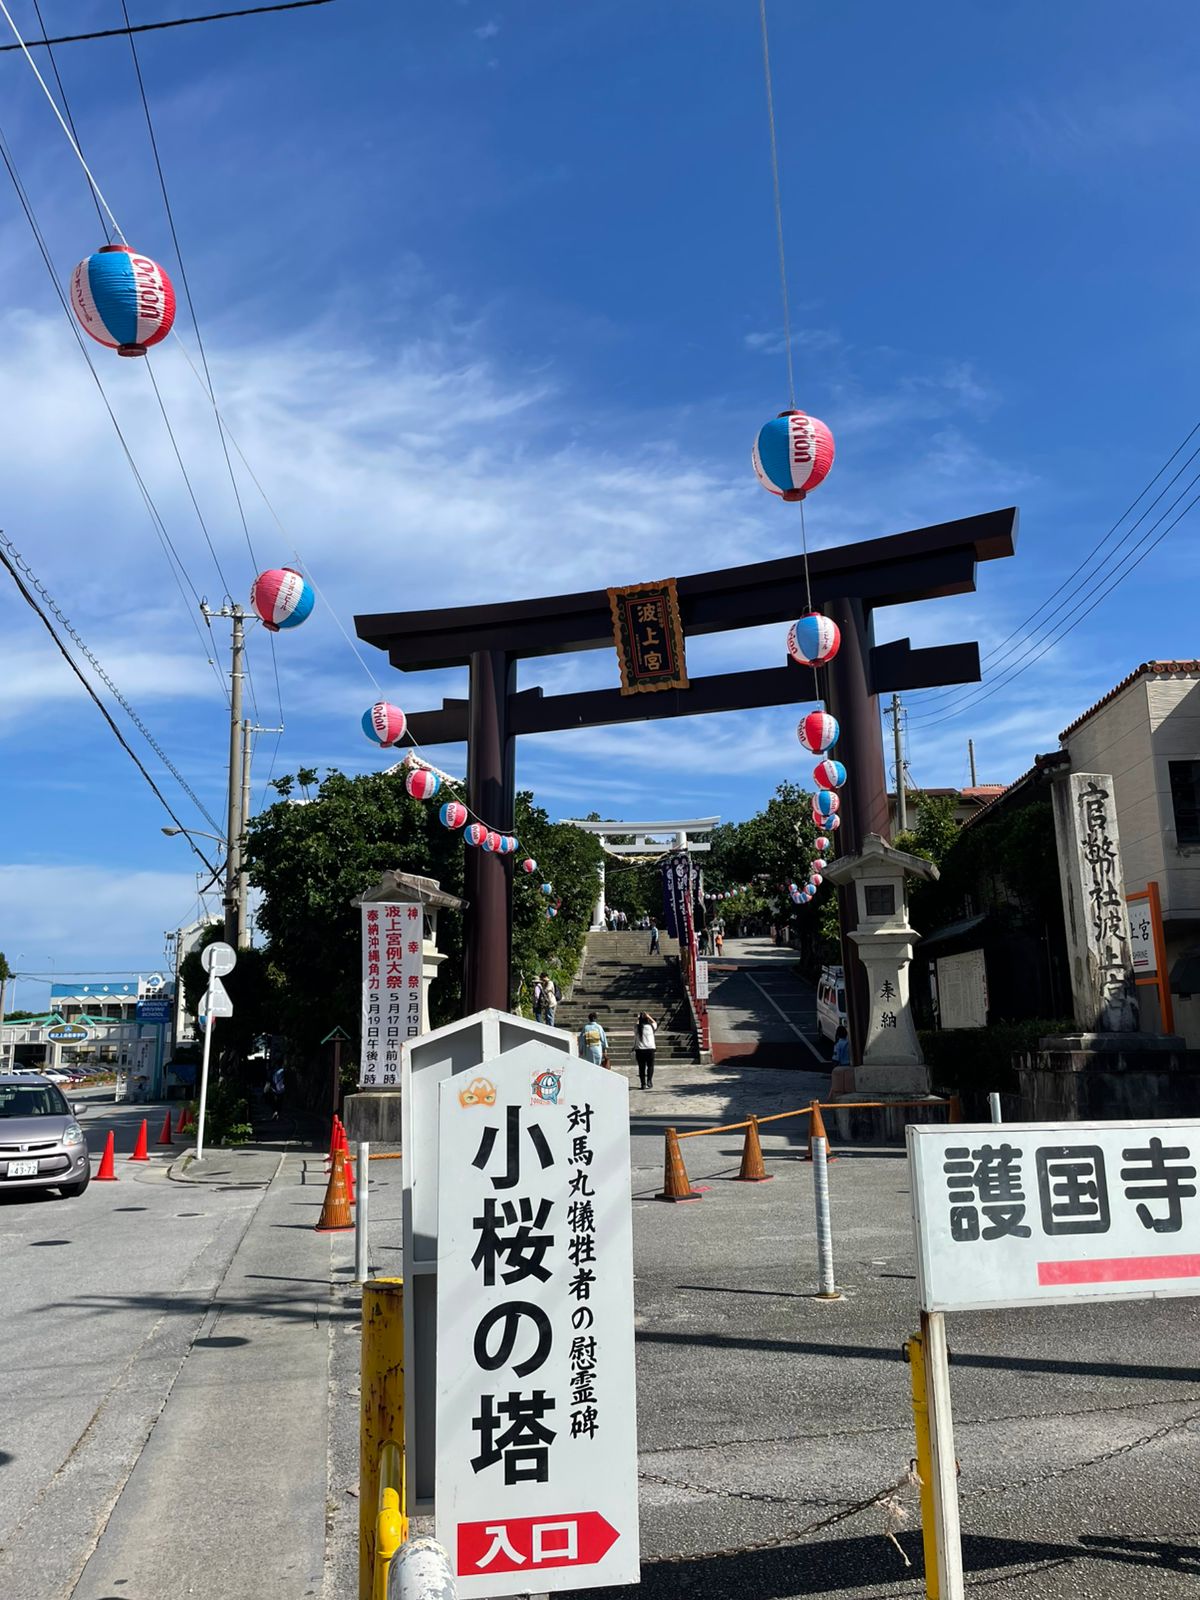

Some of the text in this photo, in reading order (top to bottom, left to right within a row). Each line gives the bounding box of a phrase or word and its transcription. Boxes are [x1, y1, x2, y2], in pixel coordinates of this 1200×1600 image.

[132, 258, 164, 319] Orion
[791, 417, 815, 463] Orion
[636, 602, 663, 671] 波上宮
[373, 705, 387, 731] Orion
[880, 979, 897, 1029] 奉納
[943, 1136, 1197, 1242] 護国寺
[470, 1105, 557, 1486] 小桜の塔
[567, 1103, 599, 1440] 対馬丸犠牲者の慰霊碑
[475, 1520, 579, 1569] 入口
